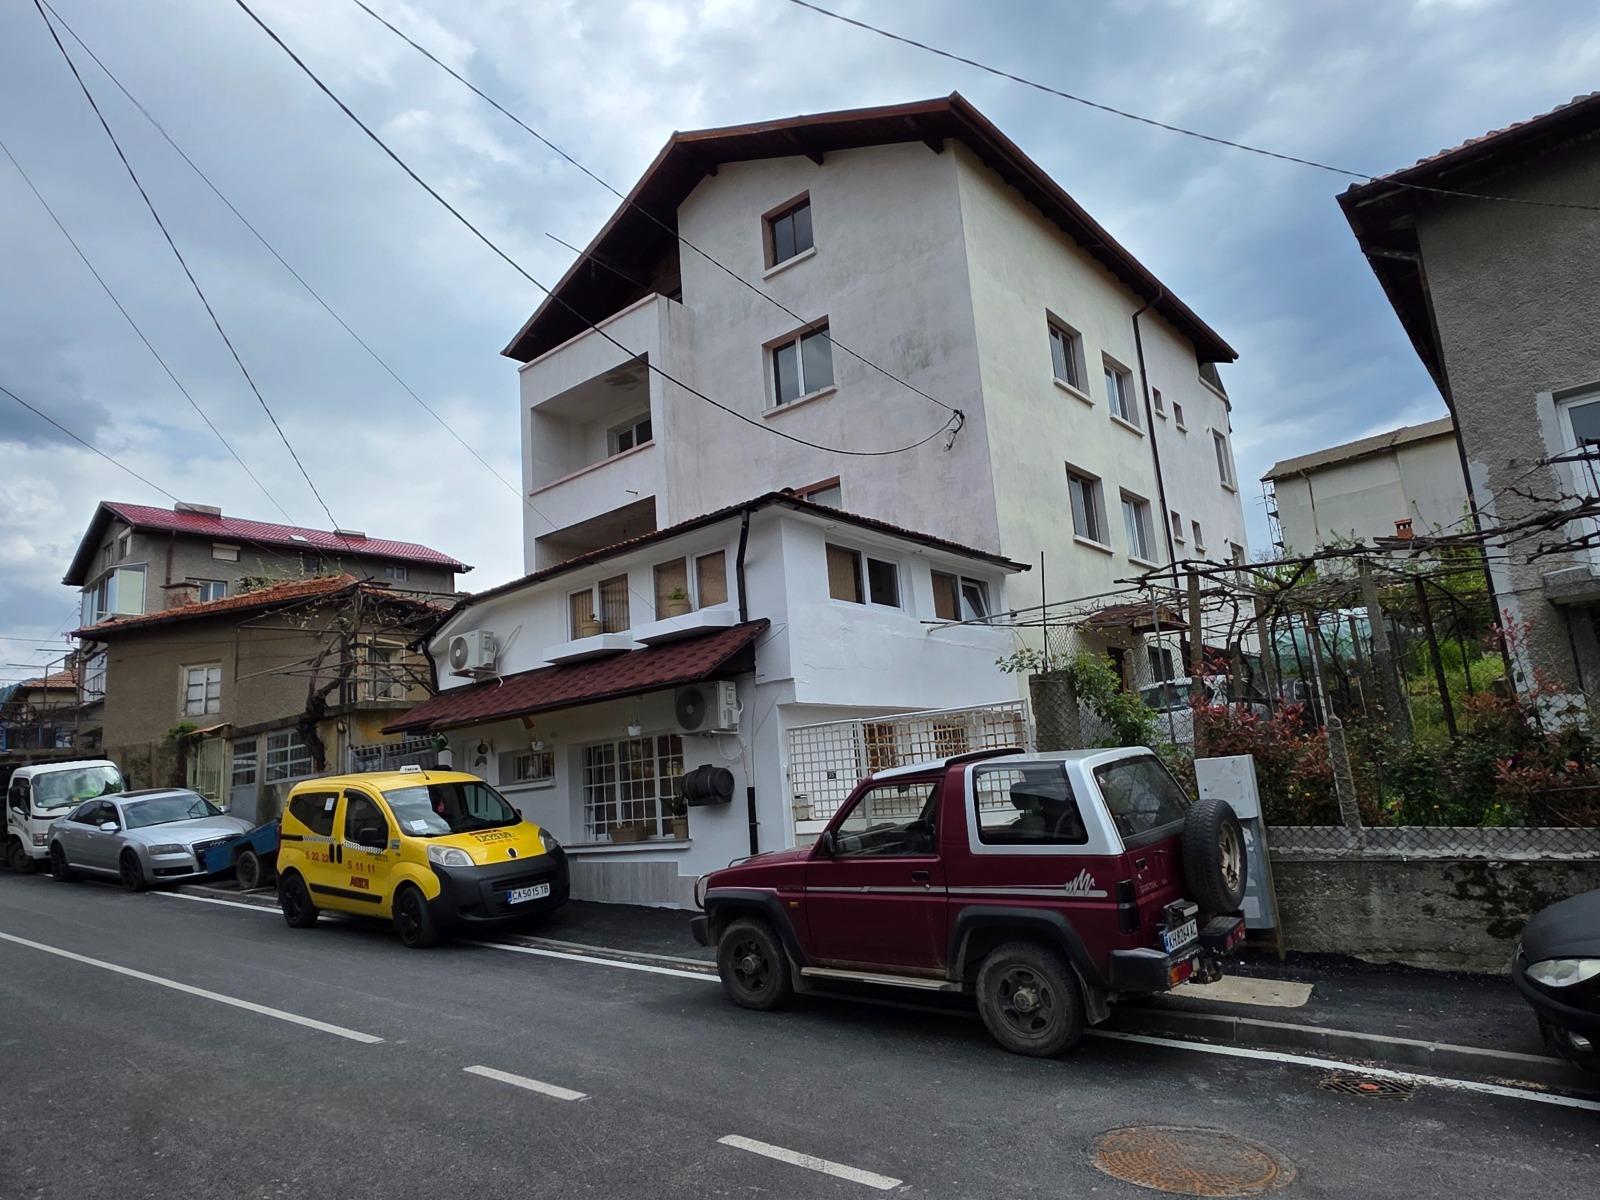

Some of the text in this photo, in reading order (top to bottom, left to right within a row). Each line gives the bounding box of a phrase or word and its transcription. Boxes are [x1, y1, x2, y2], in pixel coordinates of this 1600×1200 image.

[311, 851, 320, 862] 22
[321, 853, 329, 864] 22
[355, 862, 364, 872] 11
[367, 863, 376, 874] 11
